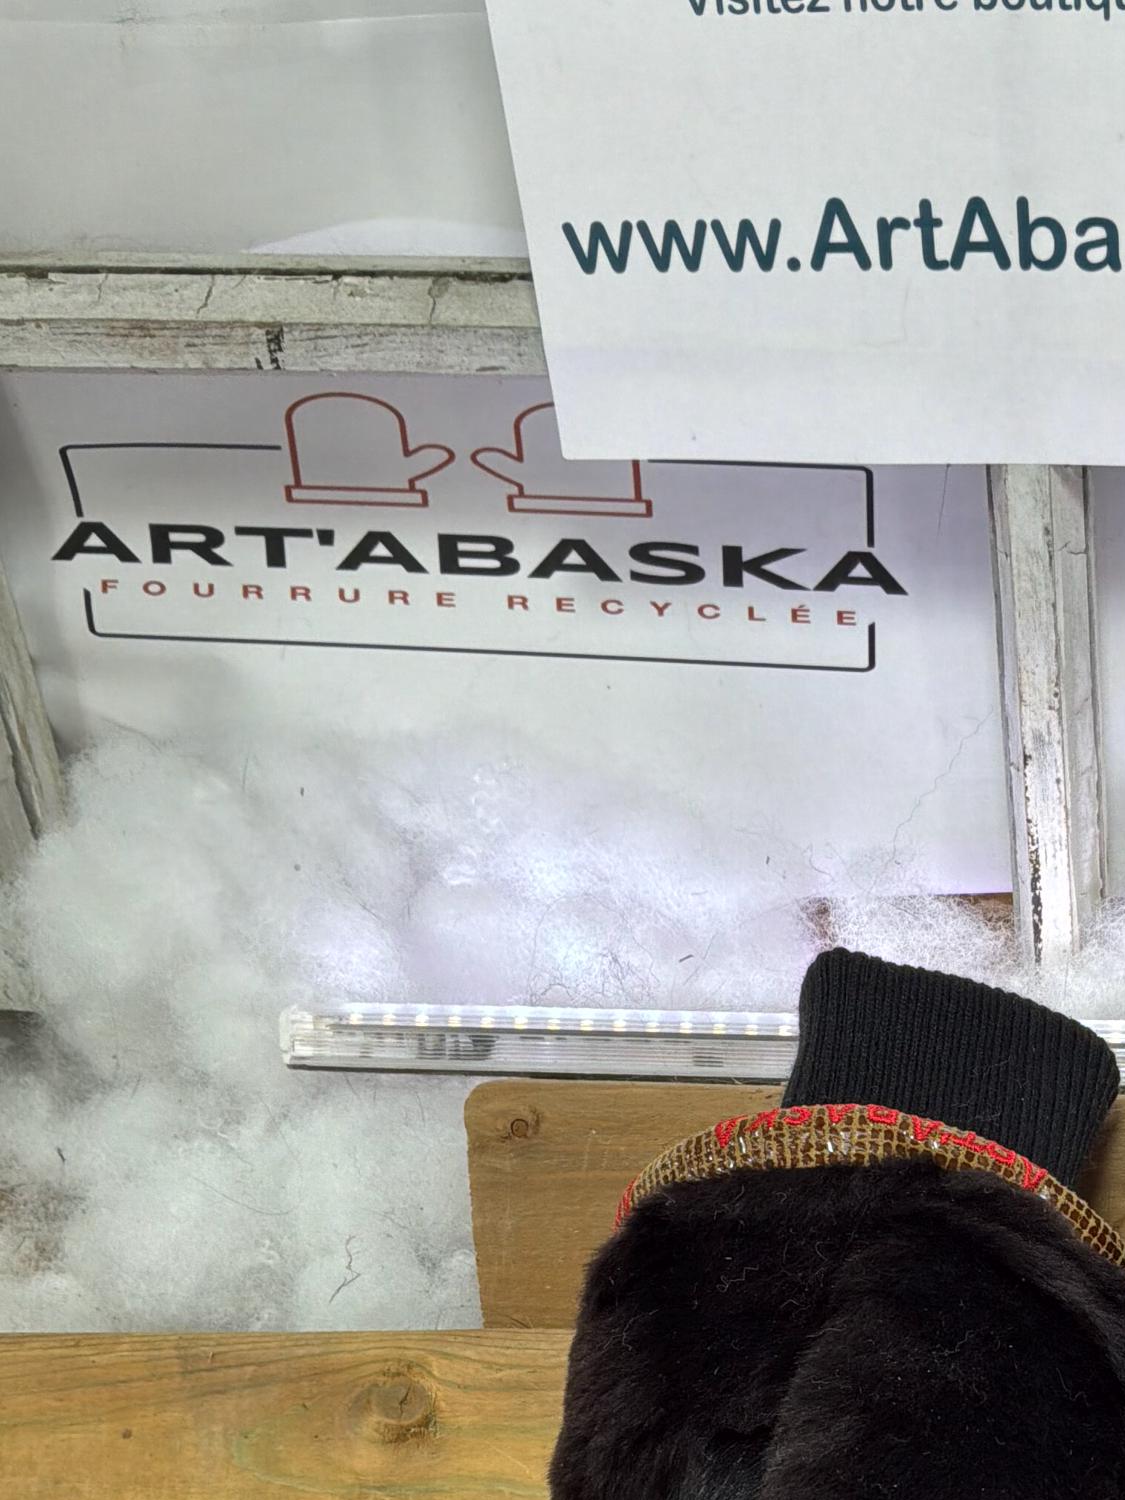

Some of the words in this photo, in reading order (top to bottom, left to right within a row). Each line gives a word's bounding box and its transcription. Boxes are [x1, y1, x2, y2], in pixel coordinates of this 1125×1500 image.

[51, 521, 908, 597] ART'ABASKA
[100, 578, 456, 609] FOURRURE
[507, 593, 858, 628] RECYCLÉE
